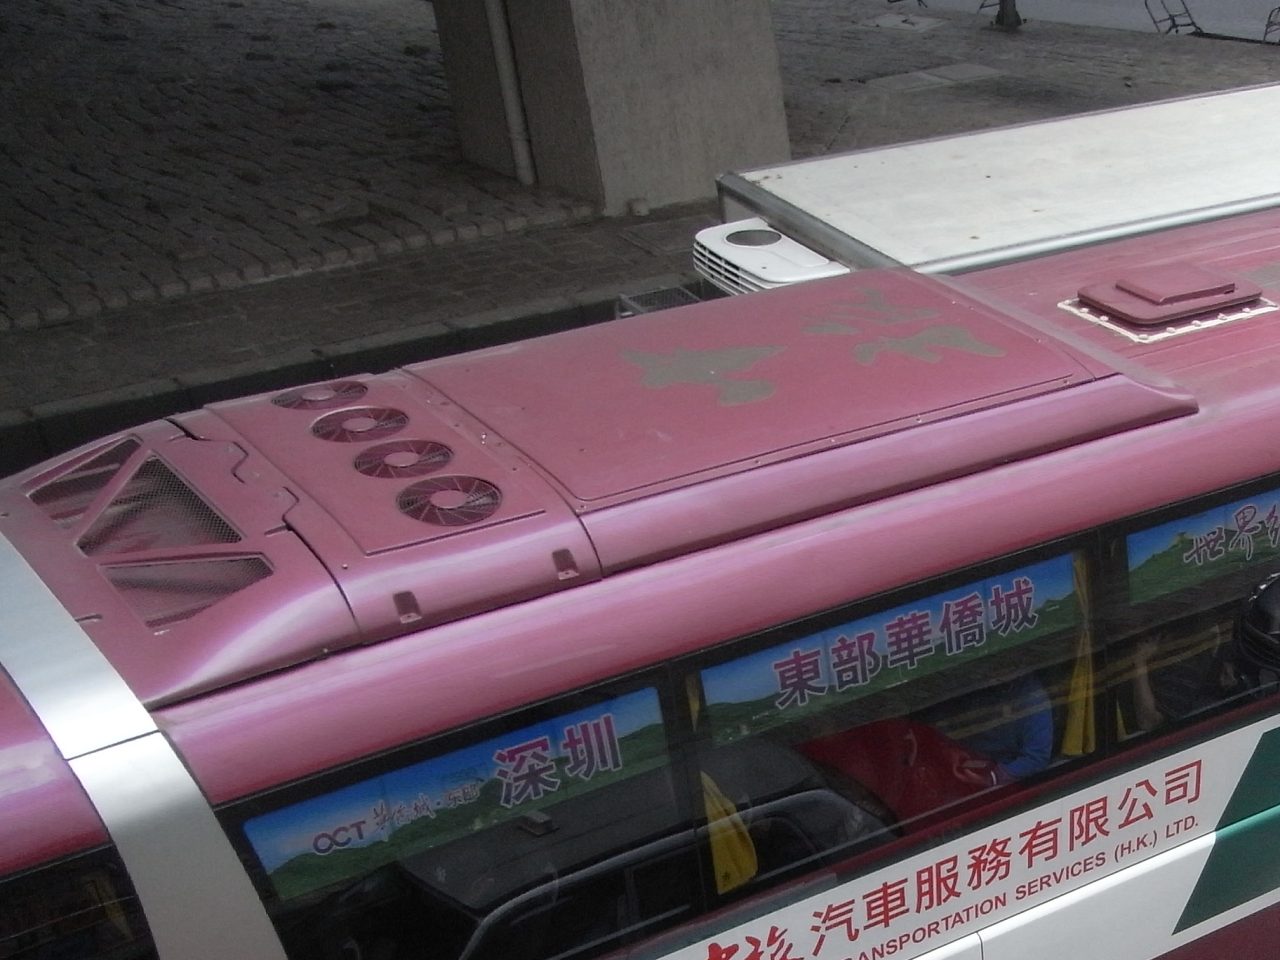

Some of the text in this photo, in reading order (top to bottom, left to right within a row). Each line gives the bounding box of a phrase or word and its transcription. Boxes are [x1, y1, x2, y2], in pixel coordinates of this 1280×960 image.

[773, 576, 1038, 709] 東部華僑城
[493, 713, 623, 808] 深圳
[312, 821, 367, 855] OCT
[1015, 852, 1106, 901] SERVICES
[1114, 829, 1158, 863] (H.K.)
[1166, 815, 1199, 839] LTD.
